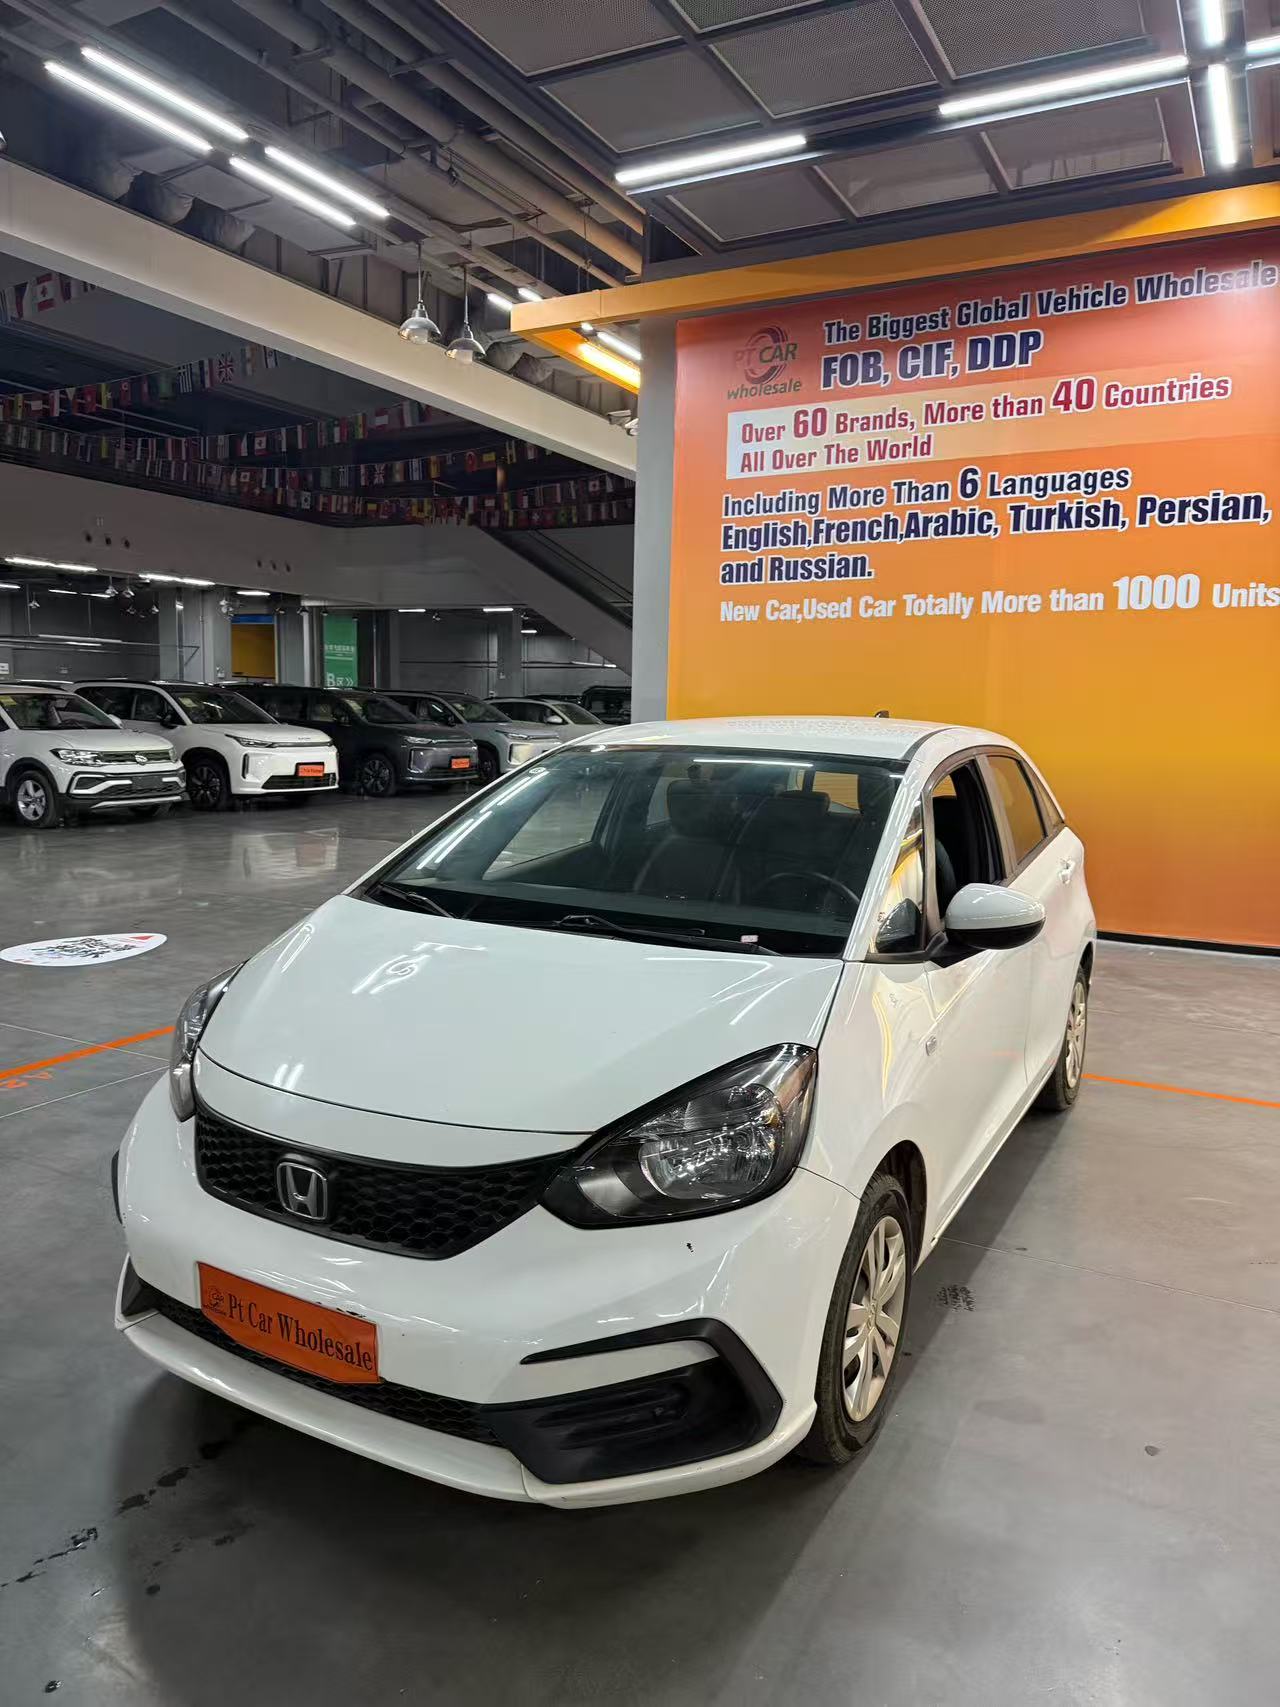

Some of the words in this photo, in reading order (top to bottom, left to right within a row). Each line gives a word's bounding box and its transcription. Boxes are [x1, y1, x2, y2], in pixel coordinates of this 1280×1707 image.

[824, 318, 861, 345] The
[867, 306, 950, 342] Biggest
[956, 292, 1030, 328] Global
[1036, 280, 1130, 317] Vehicle
[1135, 259, 1278, 304] Wholesale
[821, 350, 892, 390] FOB,
[897, 340, 960, 379] CIF,
[966, 329, 1043, 373] DDP
[727, 378, 802, 399] wholesale
[741, 423, 786, 444] Over
[793, 407, 828, 439] 60
[835, 406, 916, 434] Brands,
[923, 401, 985, 427] More
[990, 393, 1045, 419] than
[1051, 376, 1097, 414] 40
[1104, 373, 1232, 409] Countries
[740, 450, 765, 473] All
[772, 449, 817, 470] Over
[824, 442, 859, 465] The
[866, 434, 934, 461] World
[722, 489, 821, 519] Including
[827, 484, 886, 510] More
[892, 478, 951, 505] Than
[958, 466, 980, 501] 6
[987, 467, 1131, 499] Languages
[1009, 497, 1129, 534] Turkish,
[1136, 490, 1273, 528] Persian,
[719, 557, 764, 585] and
[768, 552, 874, 582] Russian.
[720, 601, 760, 622] New
[859, 595, 897, 619] Car
[902, 591, 974, 619] Totally
[981, 590, 1041, 614] More
[1049, 588, 1104, 612] than
[1113, 573, 1200, 610] 1000
[1212, 582, 1280, 608] Units
[228, 1293, 245, 1322] Pt
[248, 1302, 274, 1334] Car
[277, 1312, 373, 1371] Wholesale
